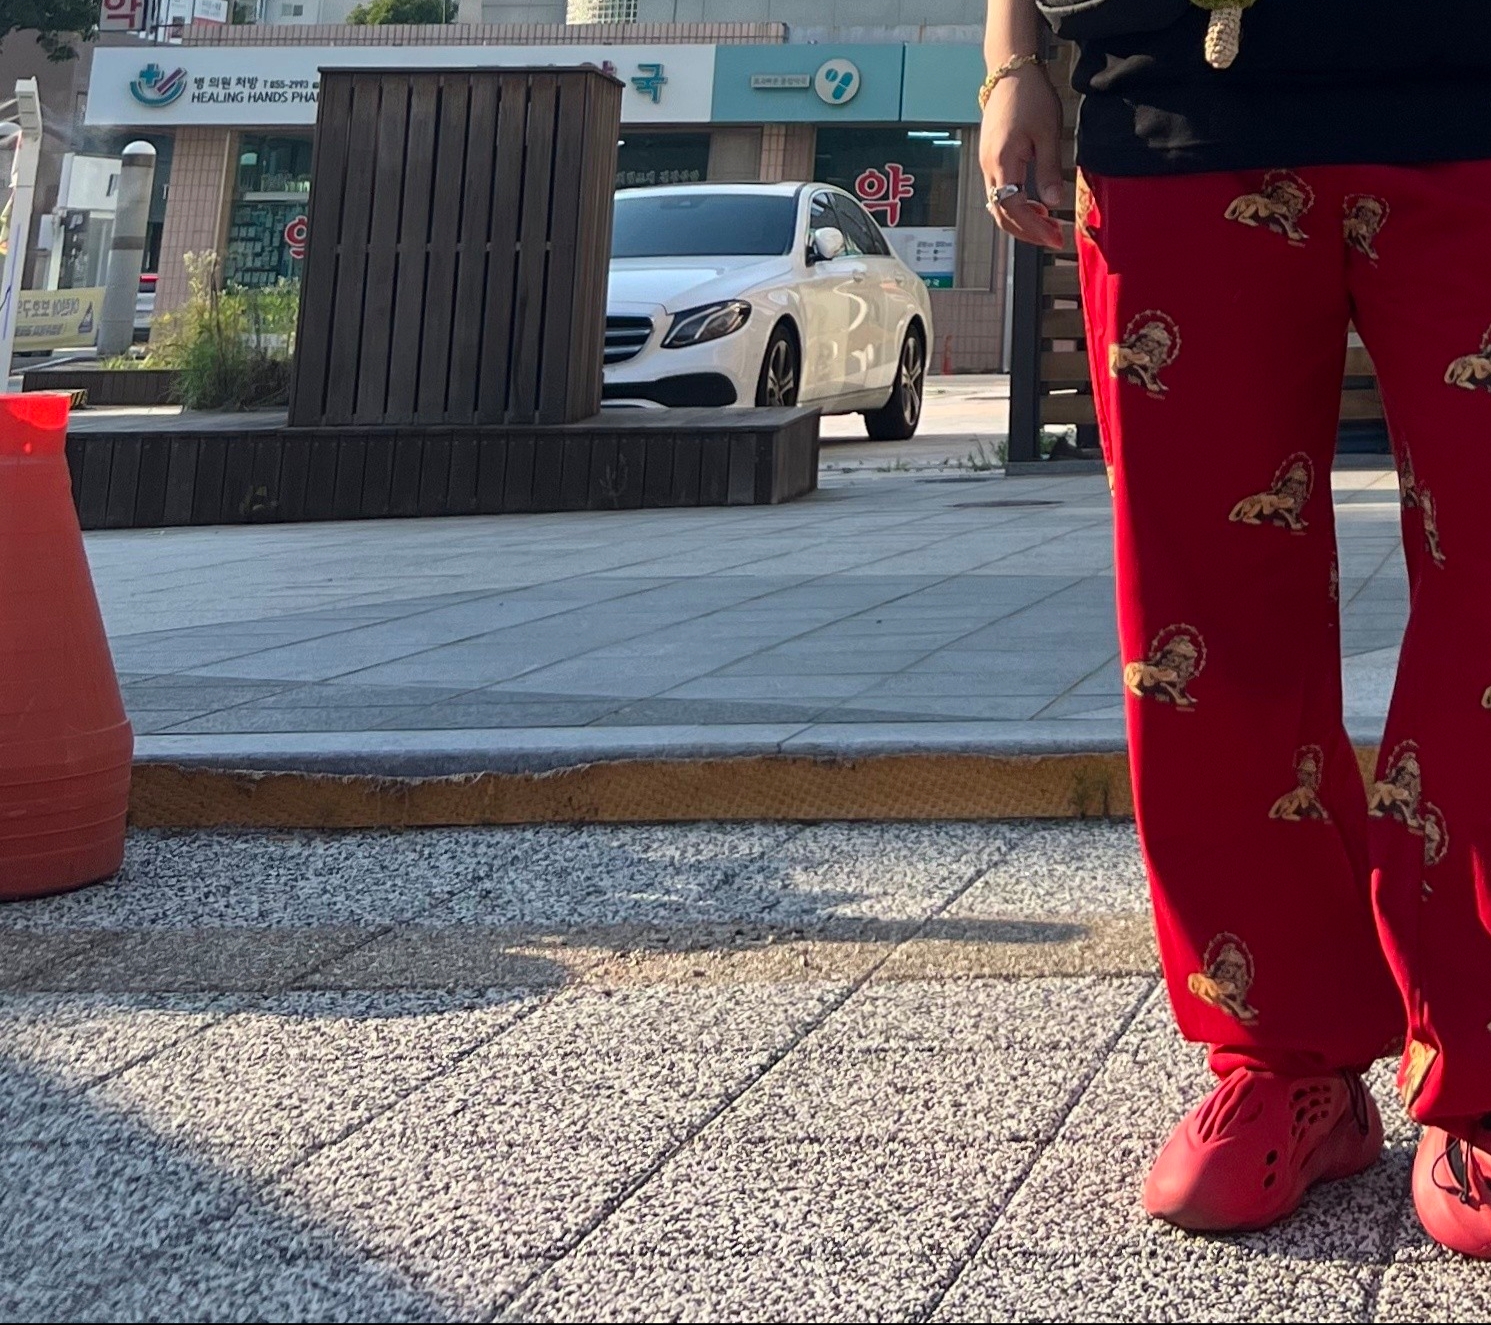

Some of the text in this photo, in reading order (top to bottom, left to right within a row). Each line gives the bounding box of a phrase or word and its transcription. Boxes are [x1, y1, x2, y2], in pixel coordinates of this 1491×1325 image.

[235, 77, 259, 90] 처방
[191, 91, 245, 103] HEALING
[247, 91, 288, 103] HANDS
[855, 163, 915, 227] 약
